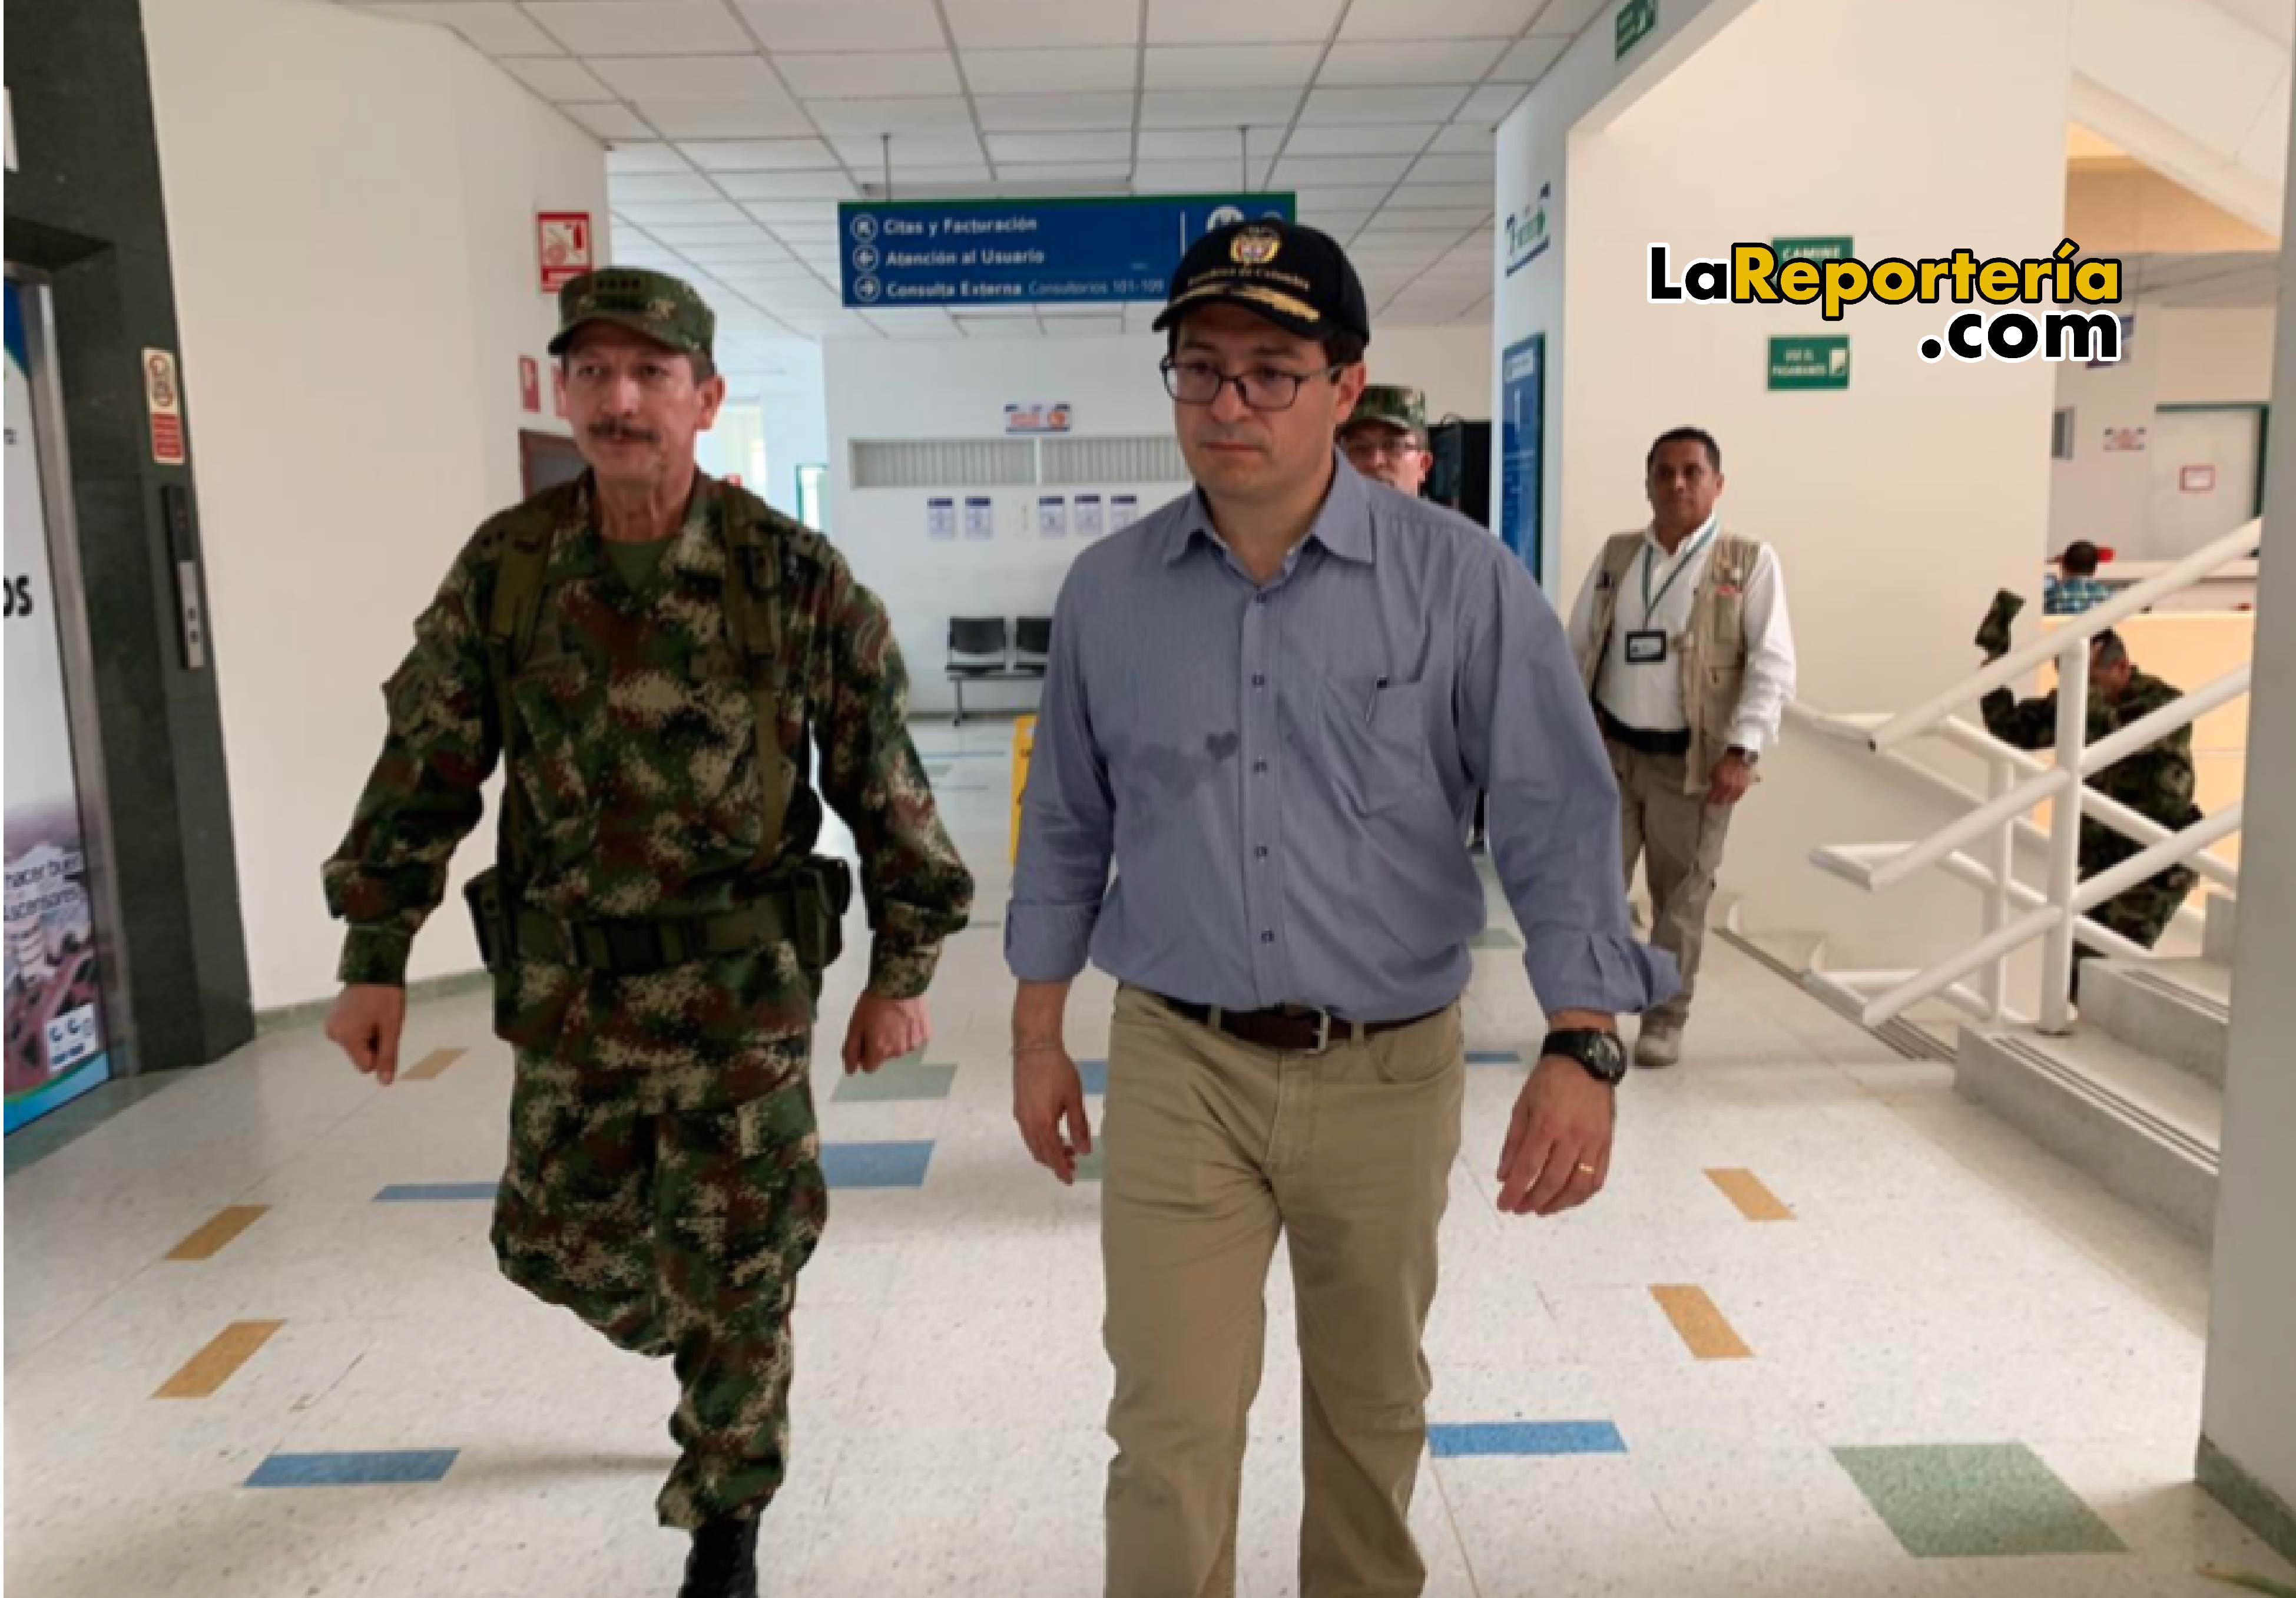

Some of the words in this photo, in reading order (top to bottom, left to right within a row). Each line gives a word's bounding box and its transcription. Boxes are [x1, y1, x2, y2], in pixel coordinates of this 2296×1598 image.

[884, 217, 924, 236] Citas
[928, 221, 937, 239] y
[944, 214, 1038, 234] Facturación
[886, 249, 958, 267] Atención
[962, 248, 976, 265] al
[980, 246, 1045, 265] Usuario
[886, 280, 956, 300] Consulta
[960, 279, 1022, 297] Externa
